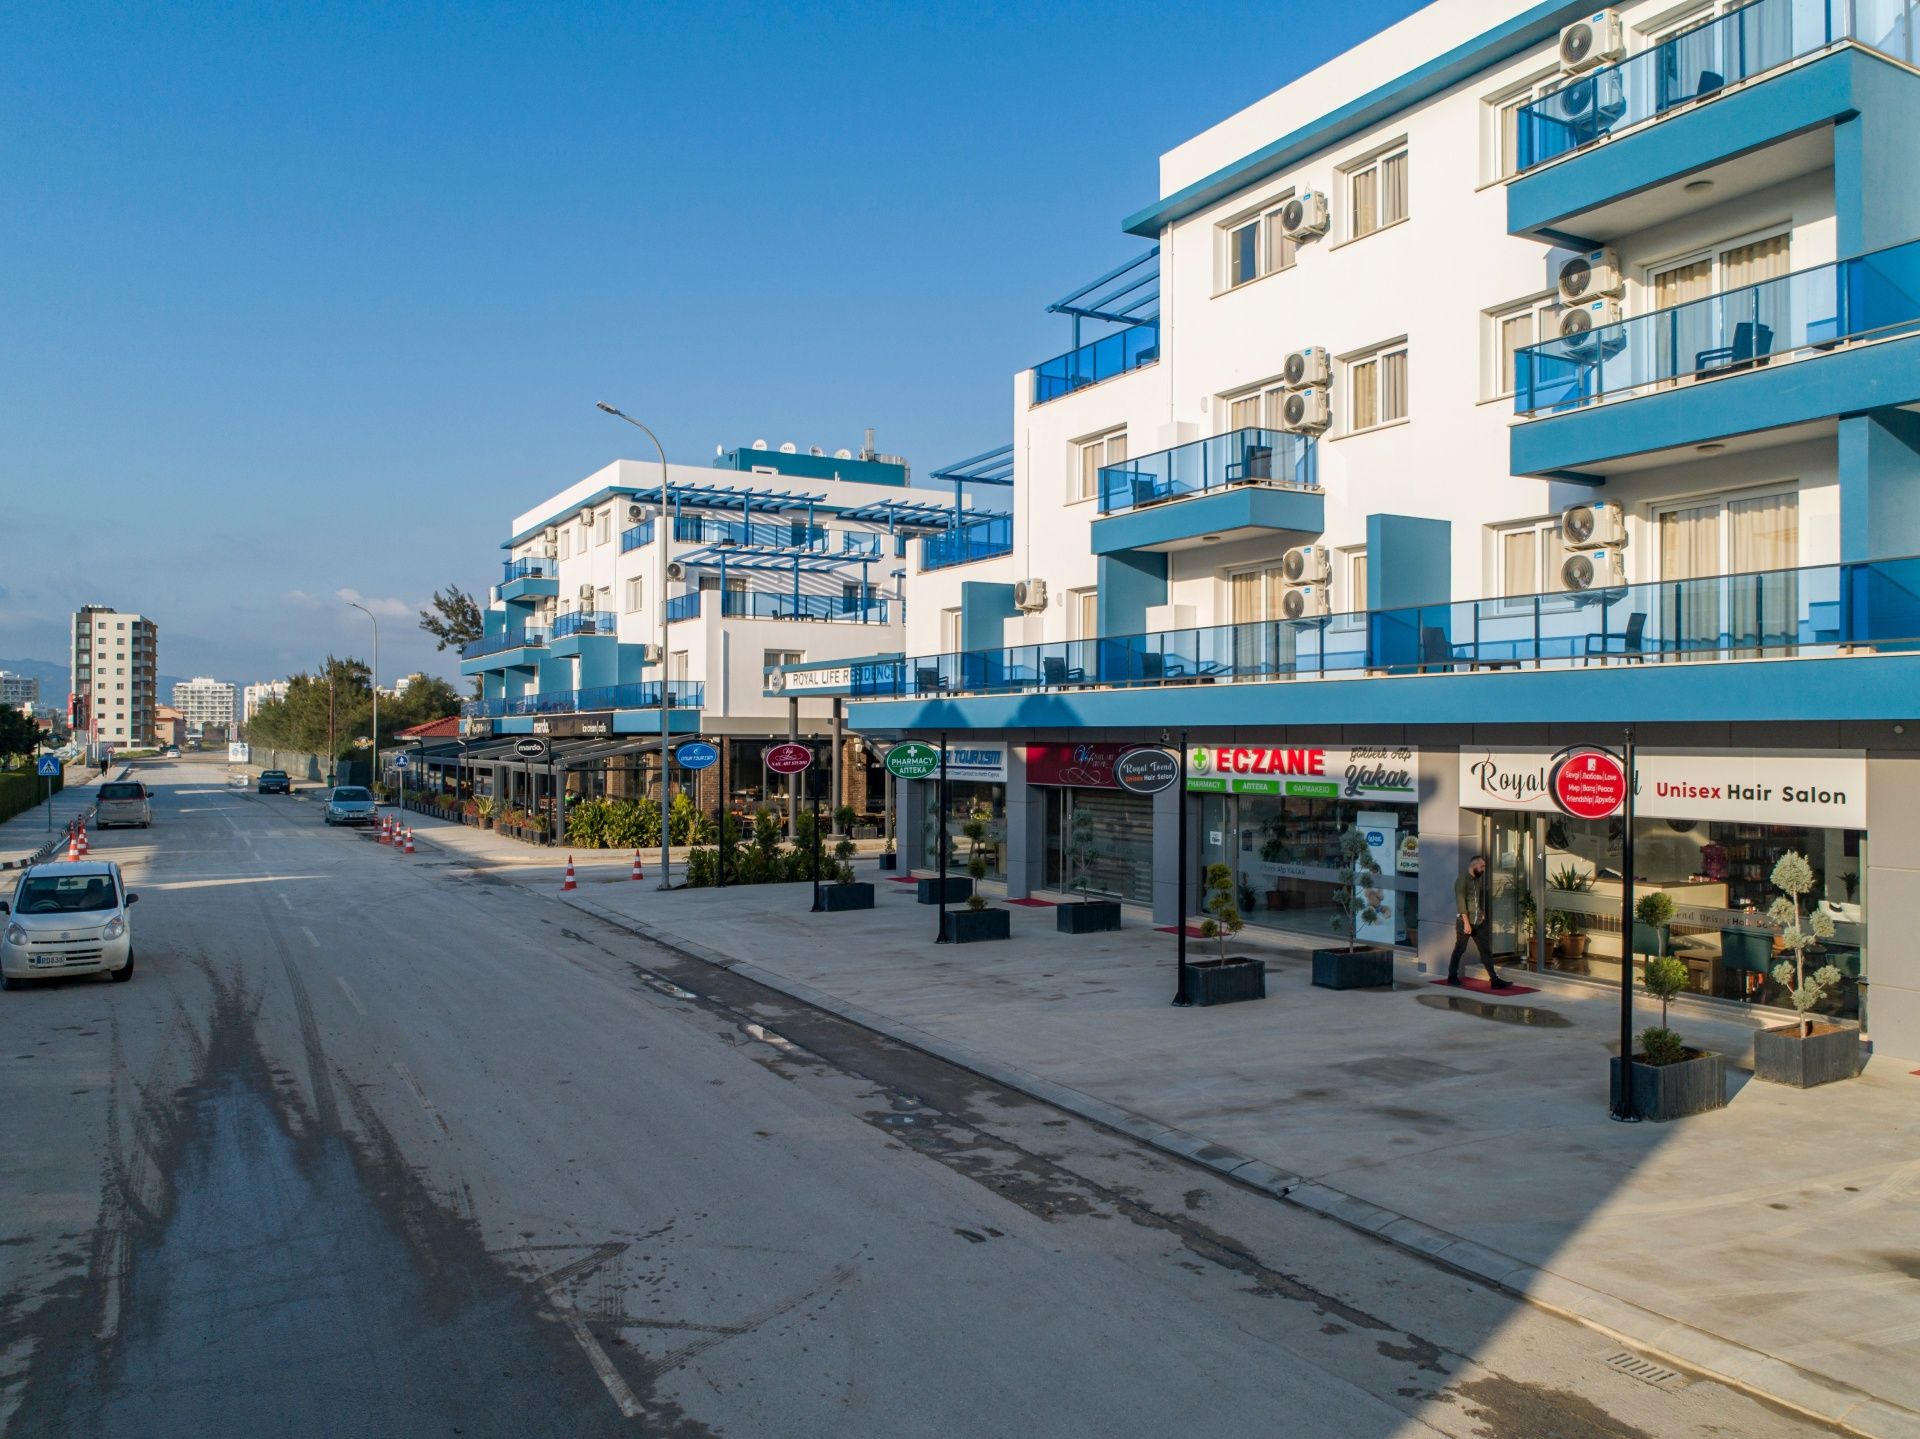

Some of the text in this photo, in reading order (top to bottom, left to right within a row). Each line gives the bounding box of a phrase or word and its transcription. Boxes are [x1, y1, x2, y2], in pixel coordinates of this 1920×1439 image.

[793, 672, 819, 685] ROYAL
[822, 670, 840, 683] LIFE
[1350, 747, 1411, 762] Gökberk Alp
[892, 757, 934, 766] PHARMACY
[1216, 747, 1325, 776] ECZANE
[899, 766, 928, 775] АПТЕКА
[1123, 761, 1172, 775] Royal Trend
[1345, 763, 1411, 796] Yakar
[1471, 760, 1548, 799] Royal
[1605, 773, 1617, 781] Love
[1187, 781, 1221, 789] PHARMACY
[1242, 782, 1268, 791] АПТЕКА
[1597, 785, 1614, 793] Peace
[1656, 782, 1721, 799] Unisex
[1727, 784, 1772, 801] Hair
[1782, 786, 1846, 804] Salon
[1566, 795, 1593, 804] Friendship
